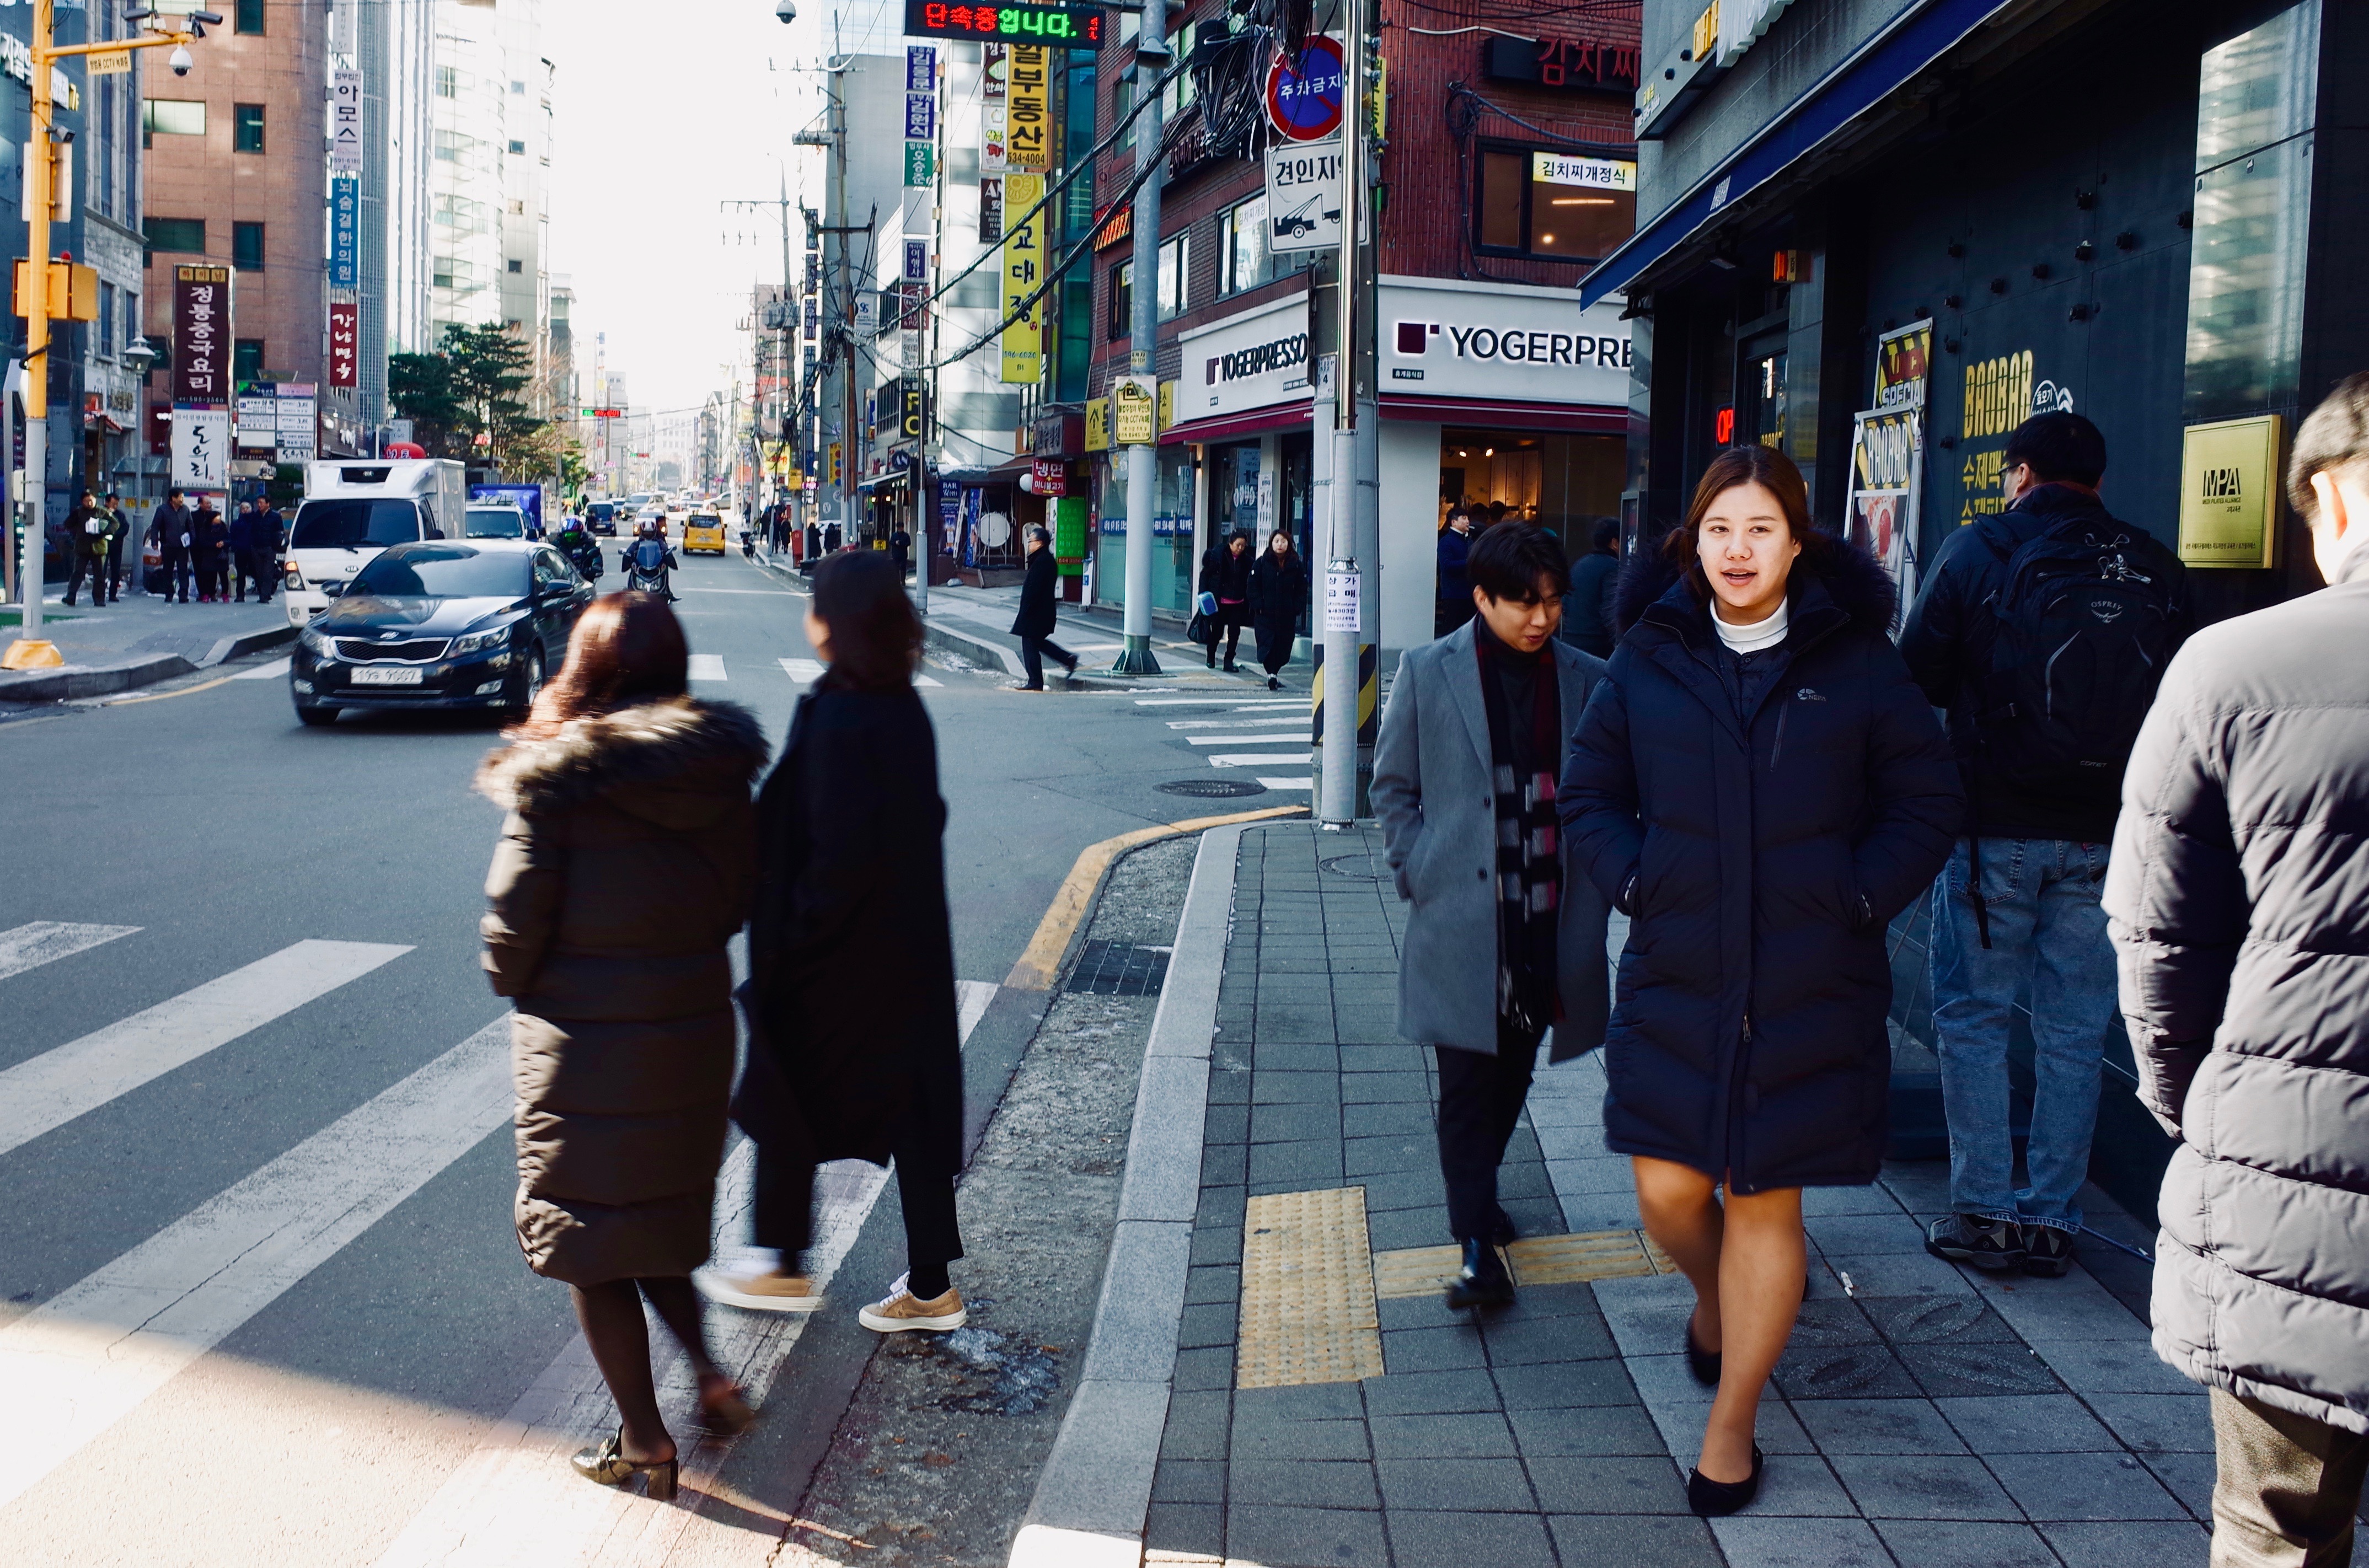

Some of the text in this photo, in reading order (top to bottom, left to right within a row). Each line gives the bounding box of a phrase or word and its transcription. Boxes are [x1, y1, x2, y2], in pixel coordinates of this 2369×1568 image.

[925, 3, 1077, 37] 단속중입니다.
[103, 58, 116, 69] CCTV
[1281, 72, 1341, 100] 주차금지
[337, 85, 358, 143] 아모스
[1008, 152, 1045, 164] 534-4004
[1543, 161, 1625, 184] 김치찌개정식
[1221, 333, 1307, 382] YOGERPRESSO
[1881, 378, 1925, 408] SPECIAL
[1964, 350, 2033, 439] BAOBAB
[2036, 388, 2052, 405] 효모가
[1868, 422, 1907, 485] BAOBAB
[1036, 462, 1063, 477] 냉면
[2203, 468, 2241, 497] MPA
[2091, 601, 2123, 610] OSPREY
